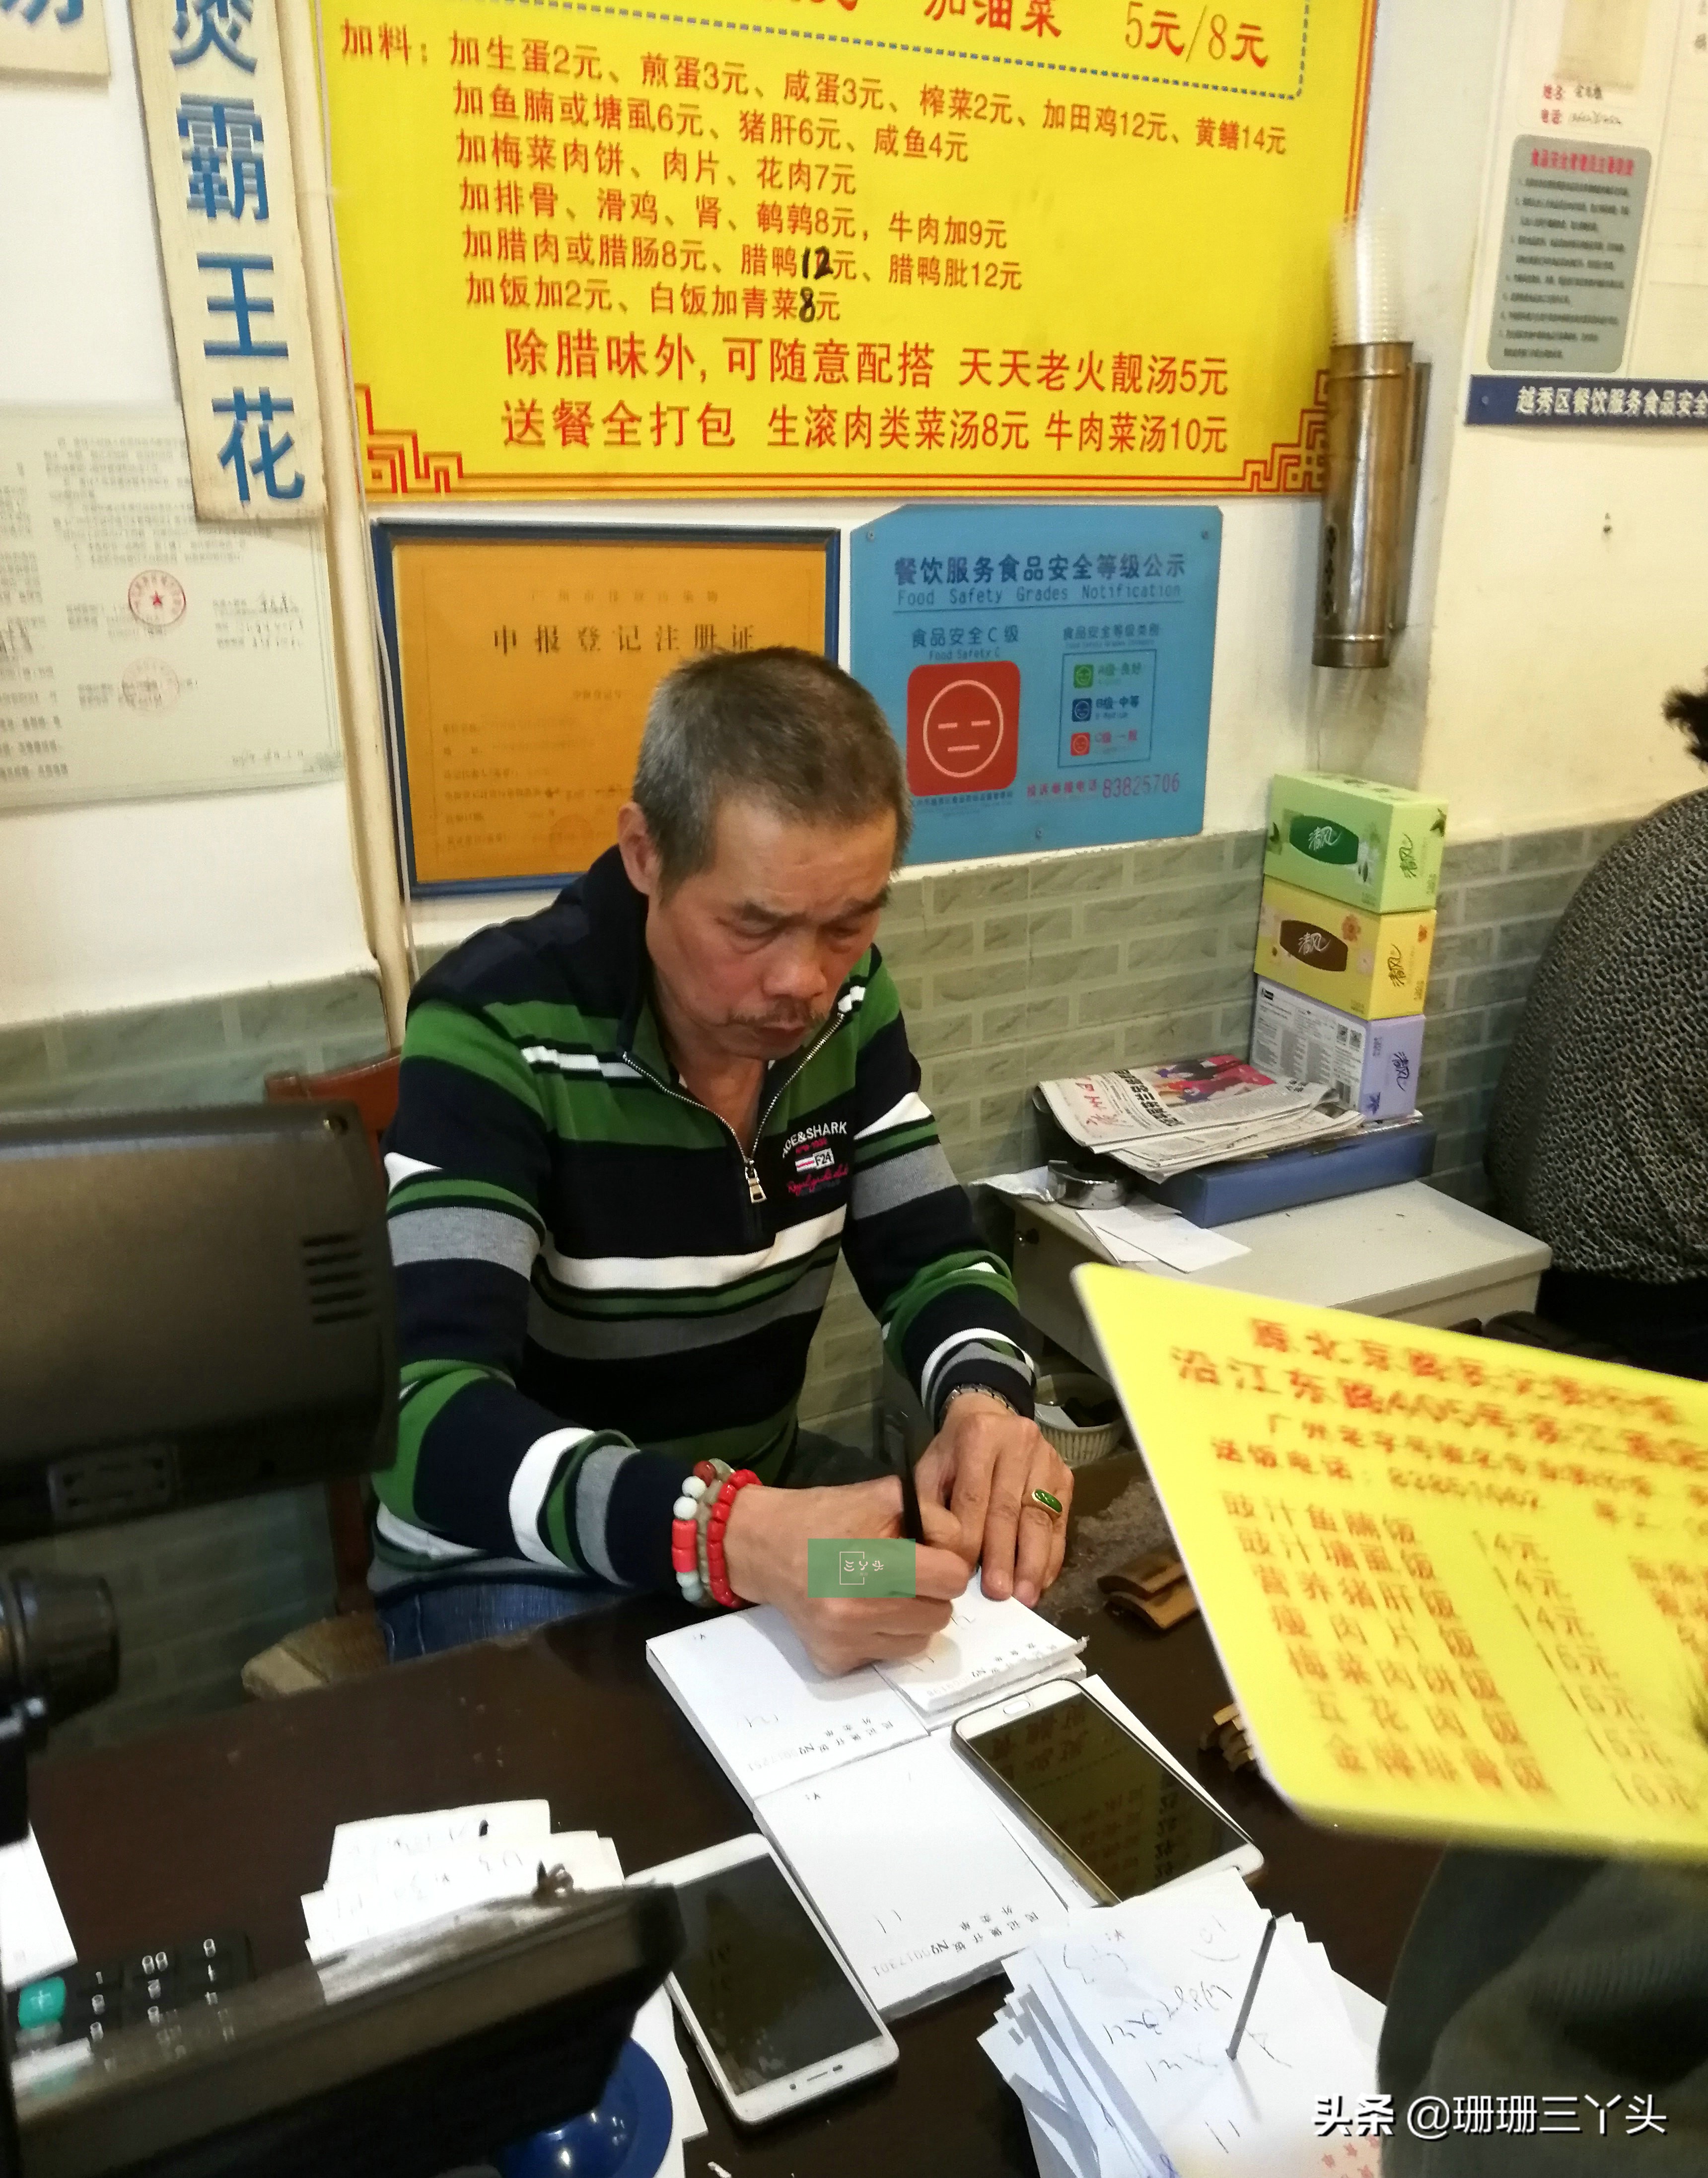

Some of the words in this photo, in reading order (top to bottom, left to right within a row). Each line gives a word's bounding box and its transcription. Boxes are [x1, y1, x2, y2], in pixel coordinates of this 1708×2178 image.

[1125, 2, 1269, 68] 5元/8元
[959, 347, 1228, 396] 天天老火靓汤5元
[501, 397, 735, 448] 送餐全打包
[768, 404, 1030, 451] 生滚肉类菜汤8元
[1045, 410, 1228, 453] 牛肉菜汤10元
[895, 553, 1185, 586] 餐饮服务食品安全等级公示
[898, 590, 934, 606] Food
[950, 587, 1003, 605] Safety
[1016, 586, 1068, 602] Grades
[1082, 584, 1181, 600] Notification
[494, 624, 755, 654] 申报登记注册证
